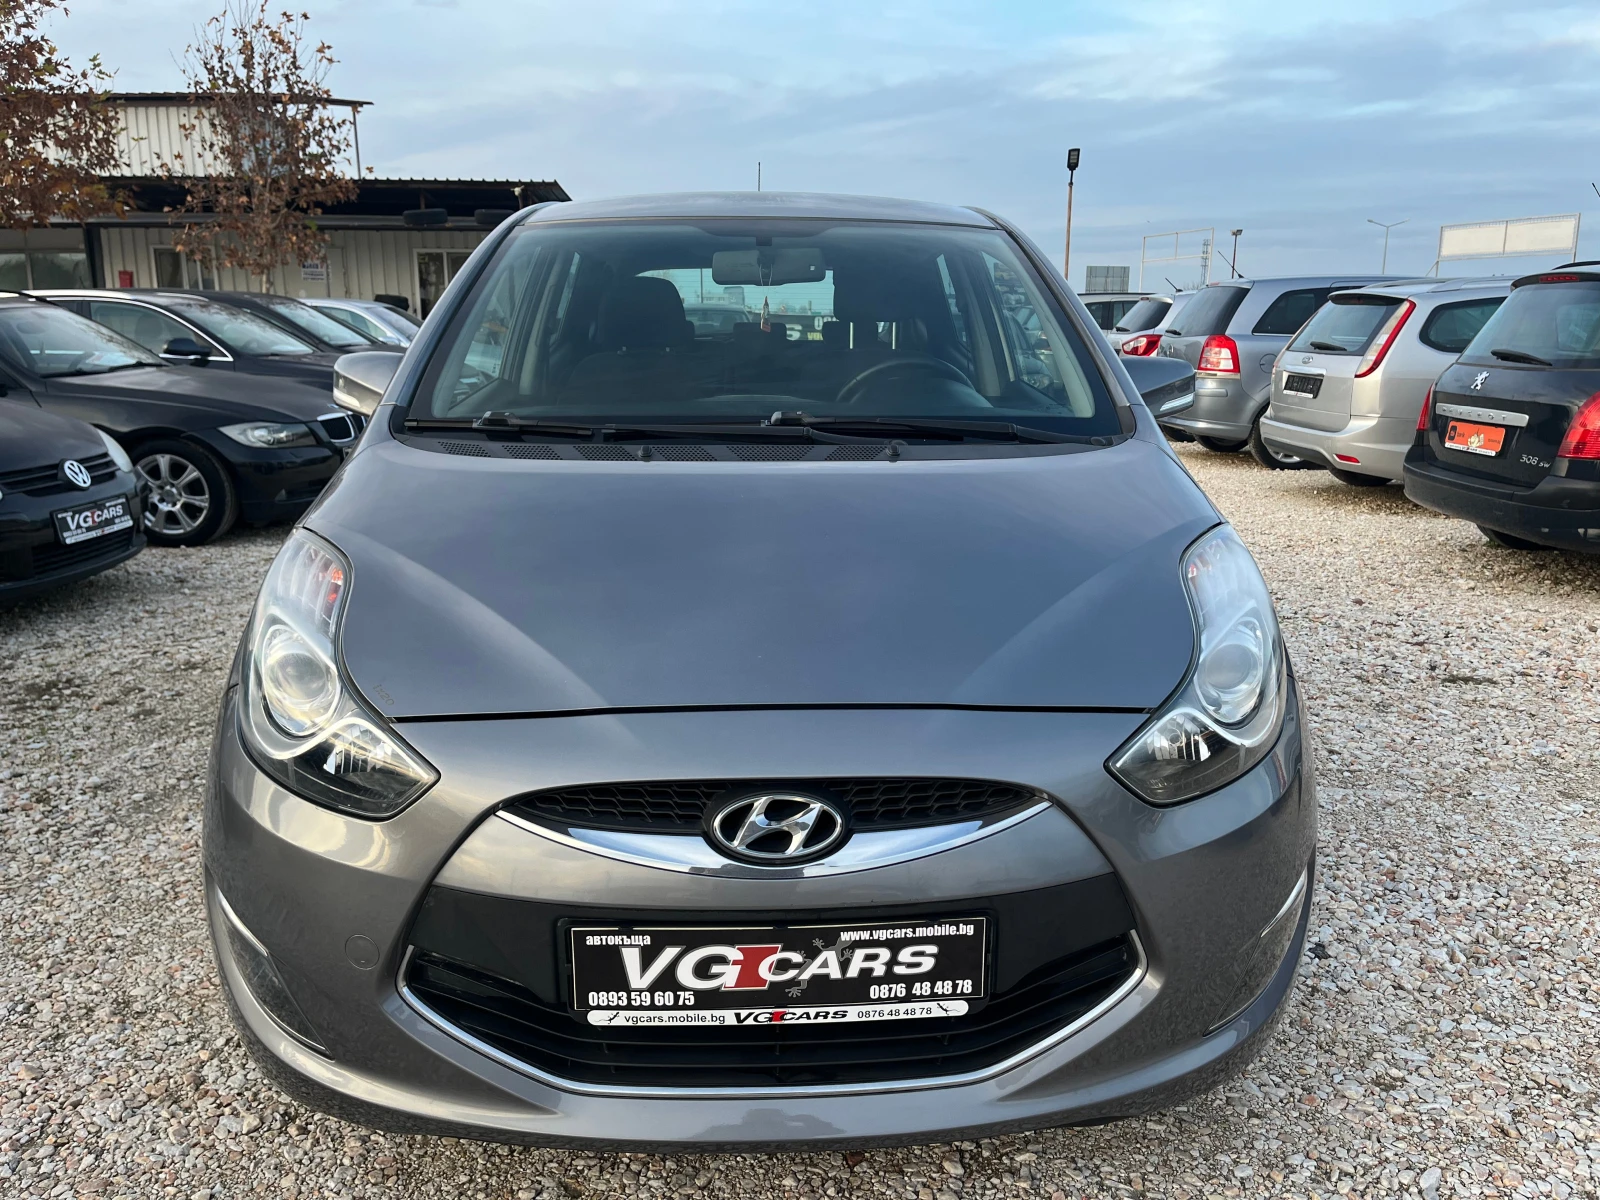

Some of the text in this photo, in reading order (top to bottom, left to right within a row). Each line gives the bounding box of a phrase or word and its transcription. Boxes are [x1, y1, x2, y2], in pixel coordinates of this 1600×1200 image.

[1520, 454, 1539, 465] 308
[840, 924, 974, 941] www.vgcars.mobile.bg
[586, 935, 651, 947] автокъща
[870, 979, 973, 999] 0876 48 48 78
[588, 991, 695, 1006] 0893 59 60 75
[857, 1006, 932, 1018] 0876 48 48 78
[624, 1013, 725, 1025] vgcars.mobile.bg
